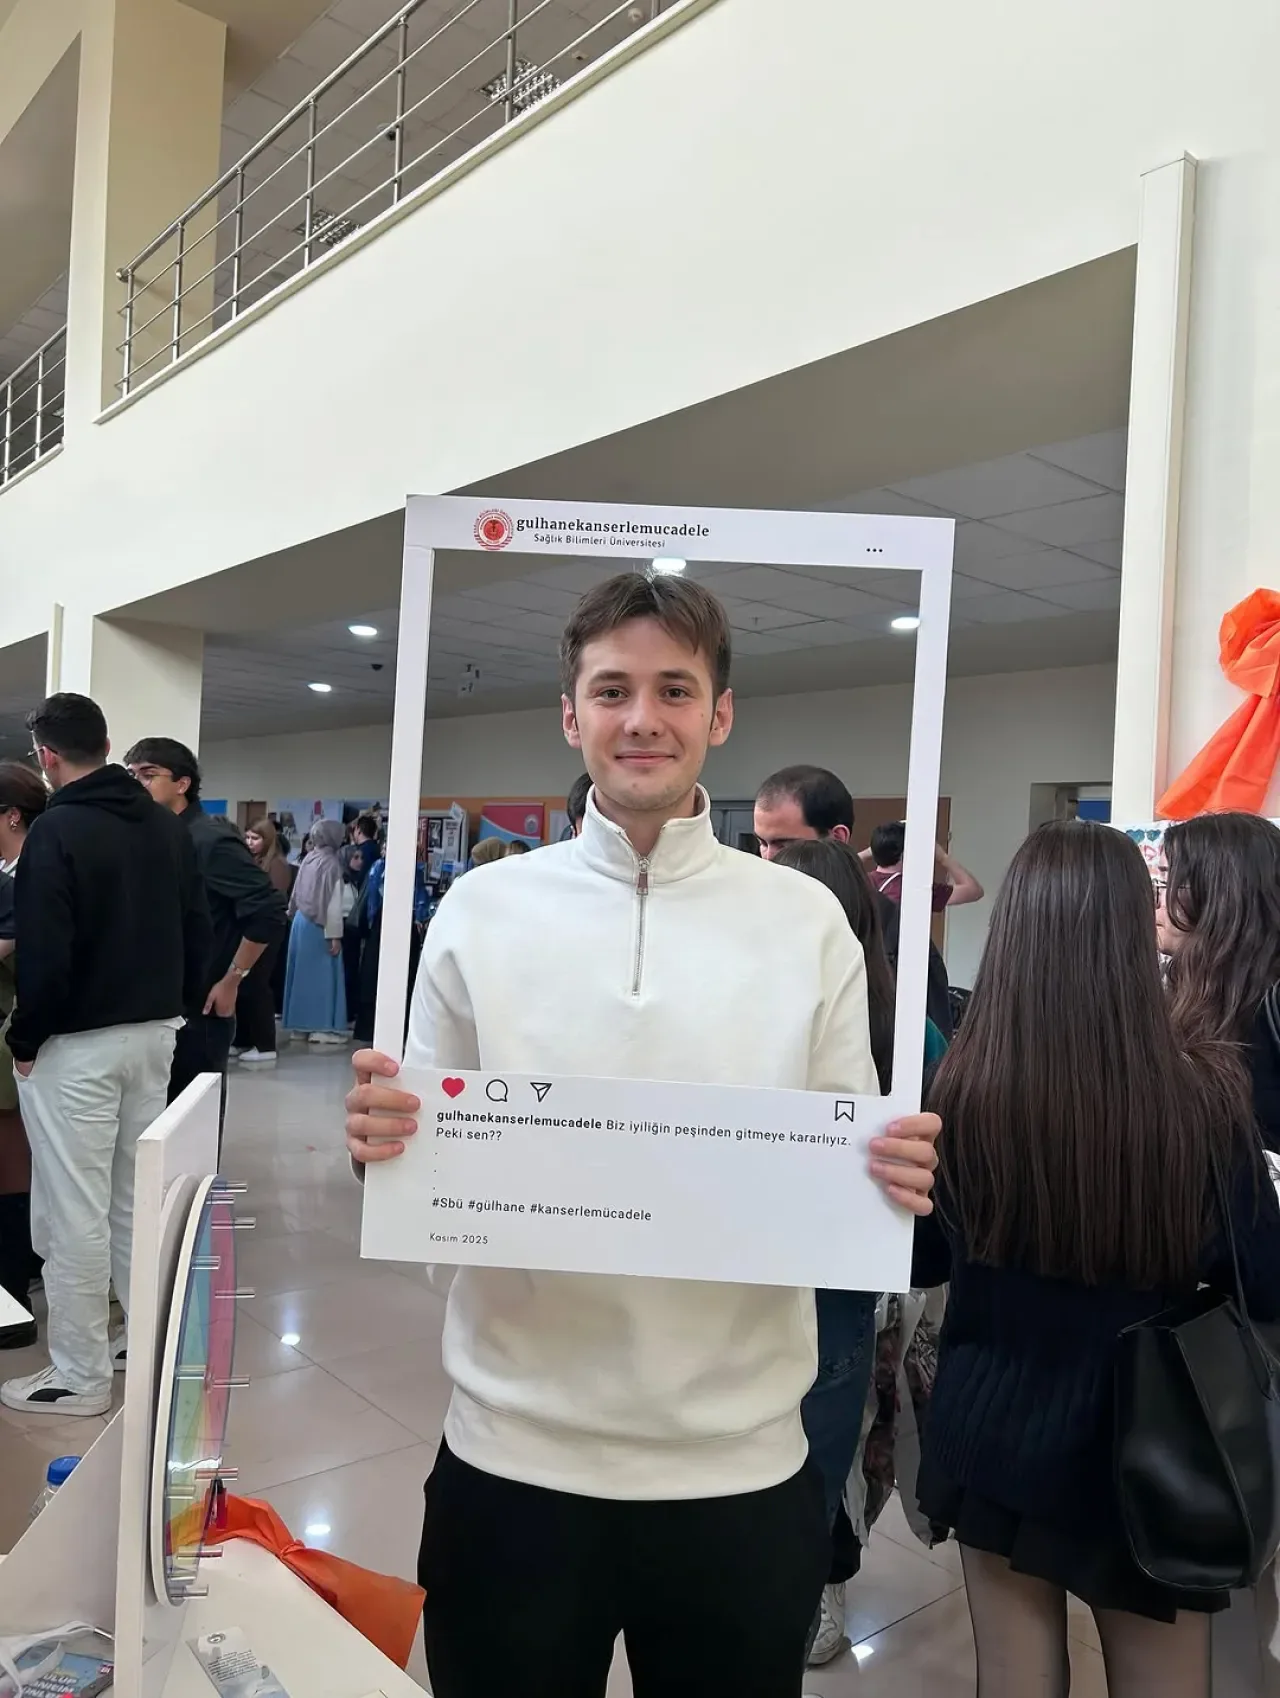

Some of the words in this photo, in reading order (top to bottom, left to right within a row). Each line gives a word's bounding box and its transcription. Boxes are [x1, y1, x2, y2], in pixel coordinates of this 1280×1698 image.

[516, 516, 710, 537] gulhanekanserlemucadele
[534, 533, 562, 545] Sağlık
[566, 535, 606, 545] Bilimleri
[610, 535, 666, 547] Üniversitesi
[436, 1110, 602, 1128] gulhanekanserlemucadele
[607, 1120, 625, 1131] Biz
[629, 1121, 671, 1135] iyiliğin
[675, 1126, 730, 1138] peşinden
[736, 1129, 785, 1143] gitmeye
[790, 1131, 850, 1147] kararlıyız.
[436, 1127, 462, 1138] Peki
[467, 1130, 502, 1141] sen??
[432, 1198, 462, 1209] #Sbü
[468, 1200, 525, 1212] #gülhane
[530, 1203, 651, 1220] #kanserlemücadele
[429, 1232, 458, 1243] Kasım
[462, 1234, 489, 1244] 2025
